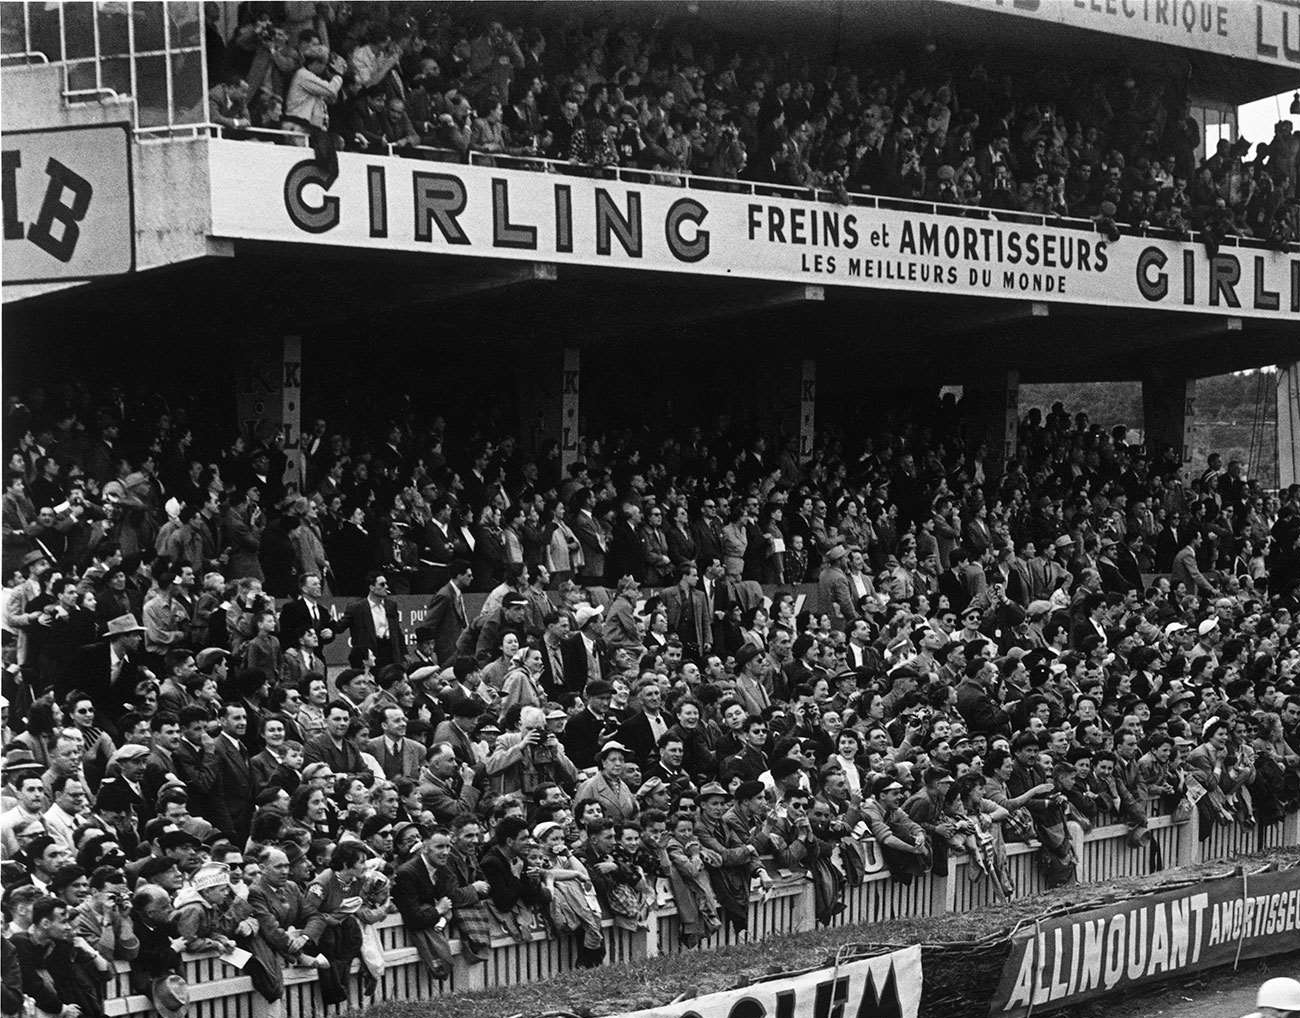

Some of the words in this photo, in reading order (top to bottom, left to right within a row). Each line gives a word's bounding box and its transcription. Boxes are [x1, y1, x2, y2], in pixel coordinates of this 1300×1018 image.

[1073, 0, 1229, 37] ECTRIQUE
[283, 158, 710, 263] GIRLING
[748, 203, 859, 249] FREINS
[870, 224, 890, 247] et
[899, 219, 1108, 273] AMORTISSEURS
[802, 253, 836, 274] LES
[849, 257, 957, 284] MEILLEURS
[969, 268, 991, 287] DU
[1003, 271, 1066, 293] MONDE
[1003, 892, 1208, 1011] ALLINQUANT
